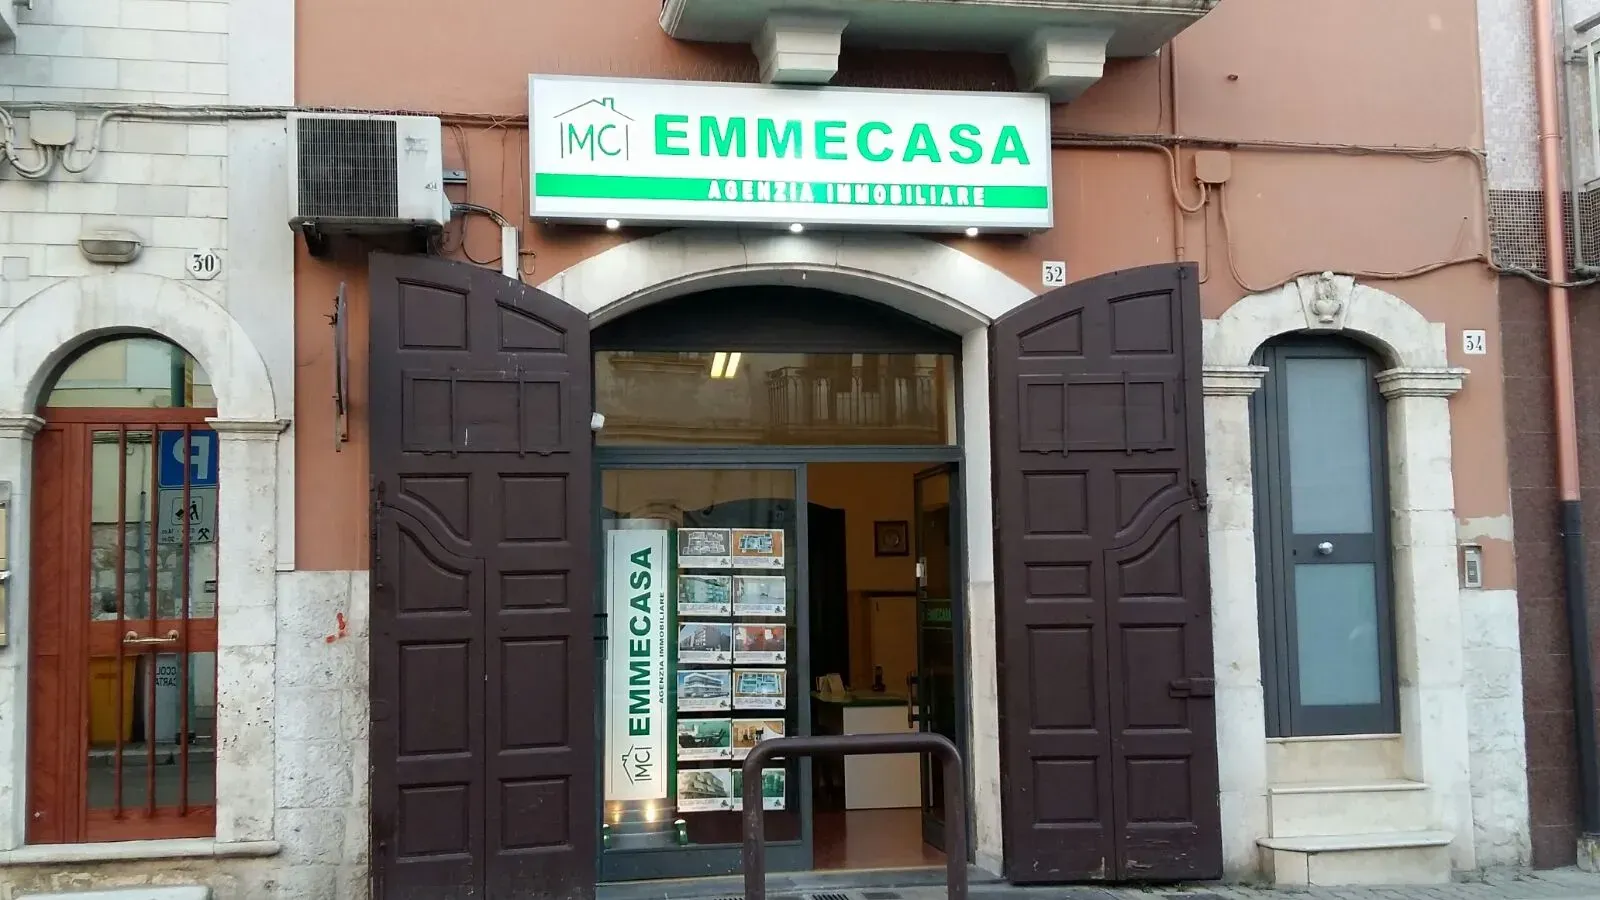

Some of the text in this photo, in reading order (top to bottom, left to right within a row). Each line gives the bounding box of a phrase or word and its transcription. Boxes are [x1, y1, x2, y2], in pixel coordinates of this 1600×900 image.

[654, 113, 1032, 166] EMMECASA
[707, 179, 986, 207] AGENZIA IMMOBILIARE
[193, 253, 215, 272] 30
[1045, 265, 1063, 283] 32
[1465, 335, 1482, 351] 34
[628, 547, 652, 736] EMMECASA
